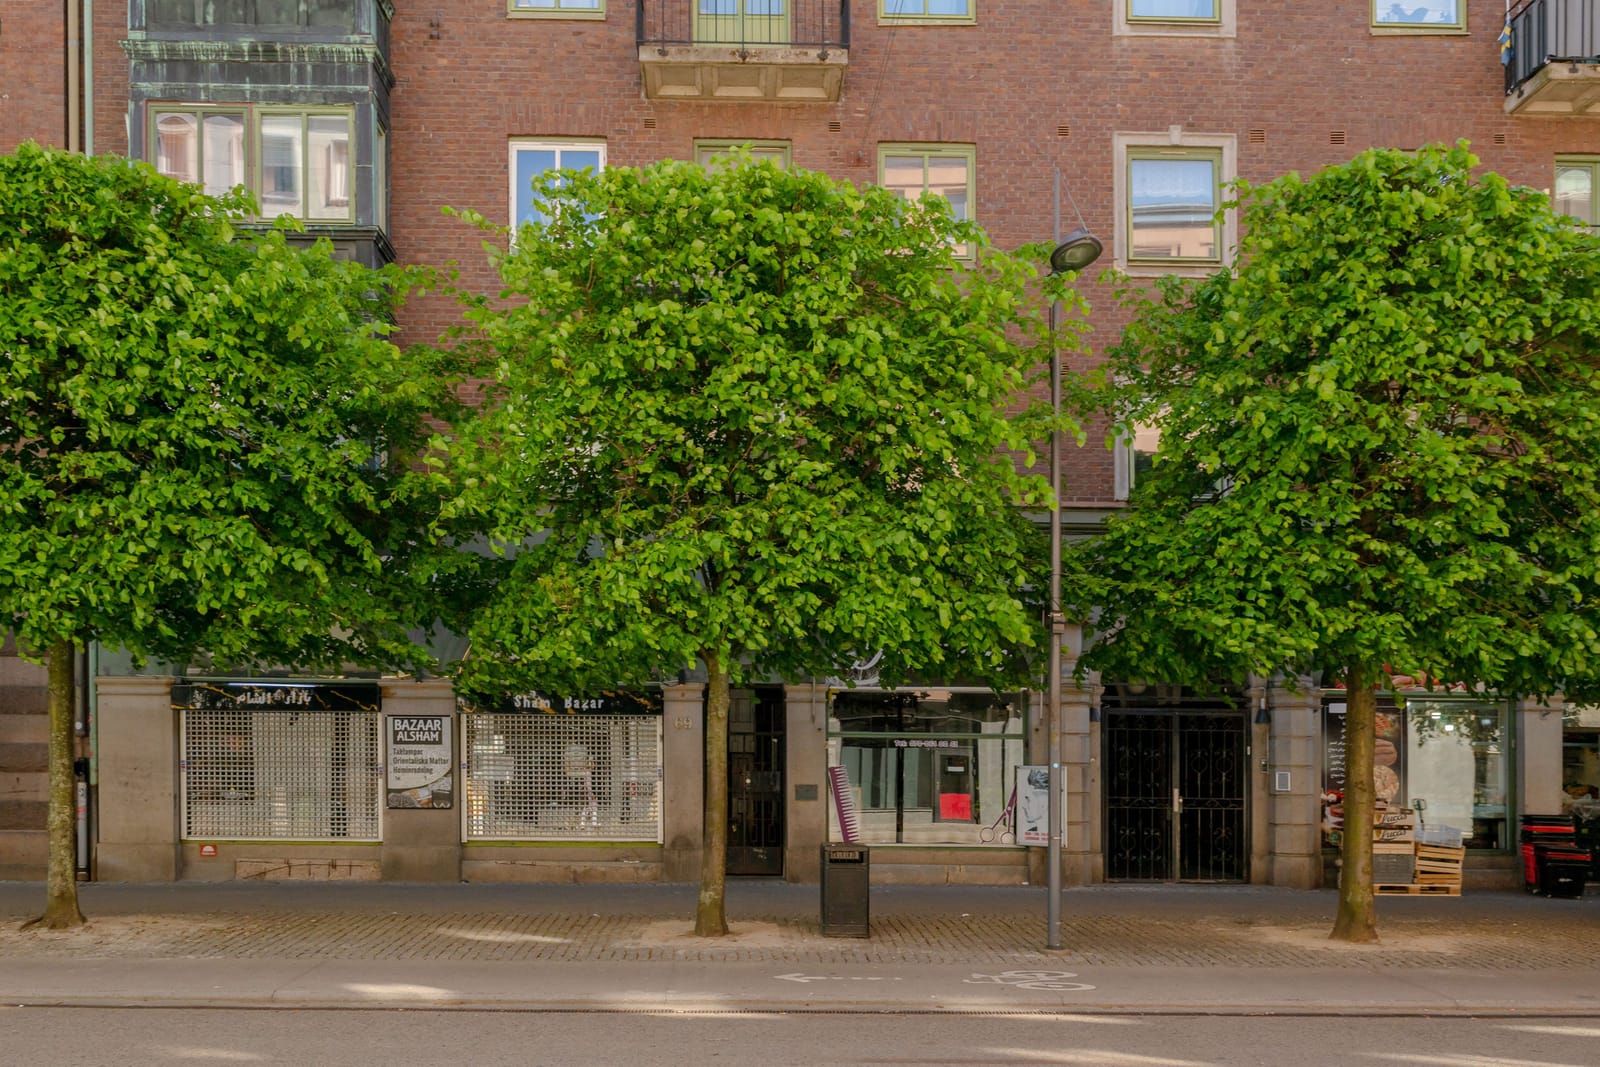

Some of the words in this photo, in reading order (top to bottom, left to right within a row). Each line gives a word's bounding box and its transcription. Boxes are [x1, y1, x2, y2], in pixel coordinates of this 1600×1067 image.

[564, 696, 604, 710] Bazar
[394, 719, 441, 731] BAZAAR
[396, 731, 439, 742] ALSHAM
